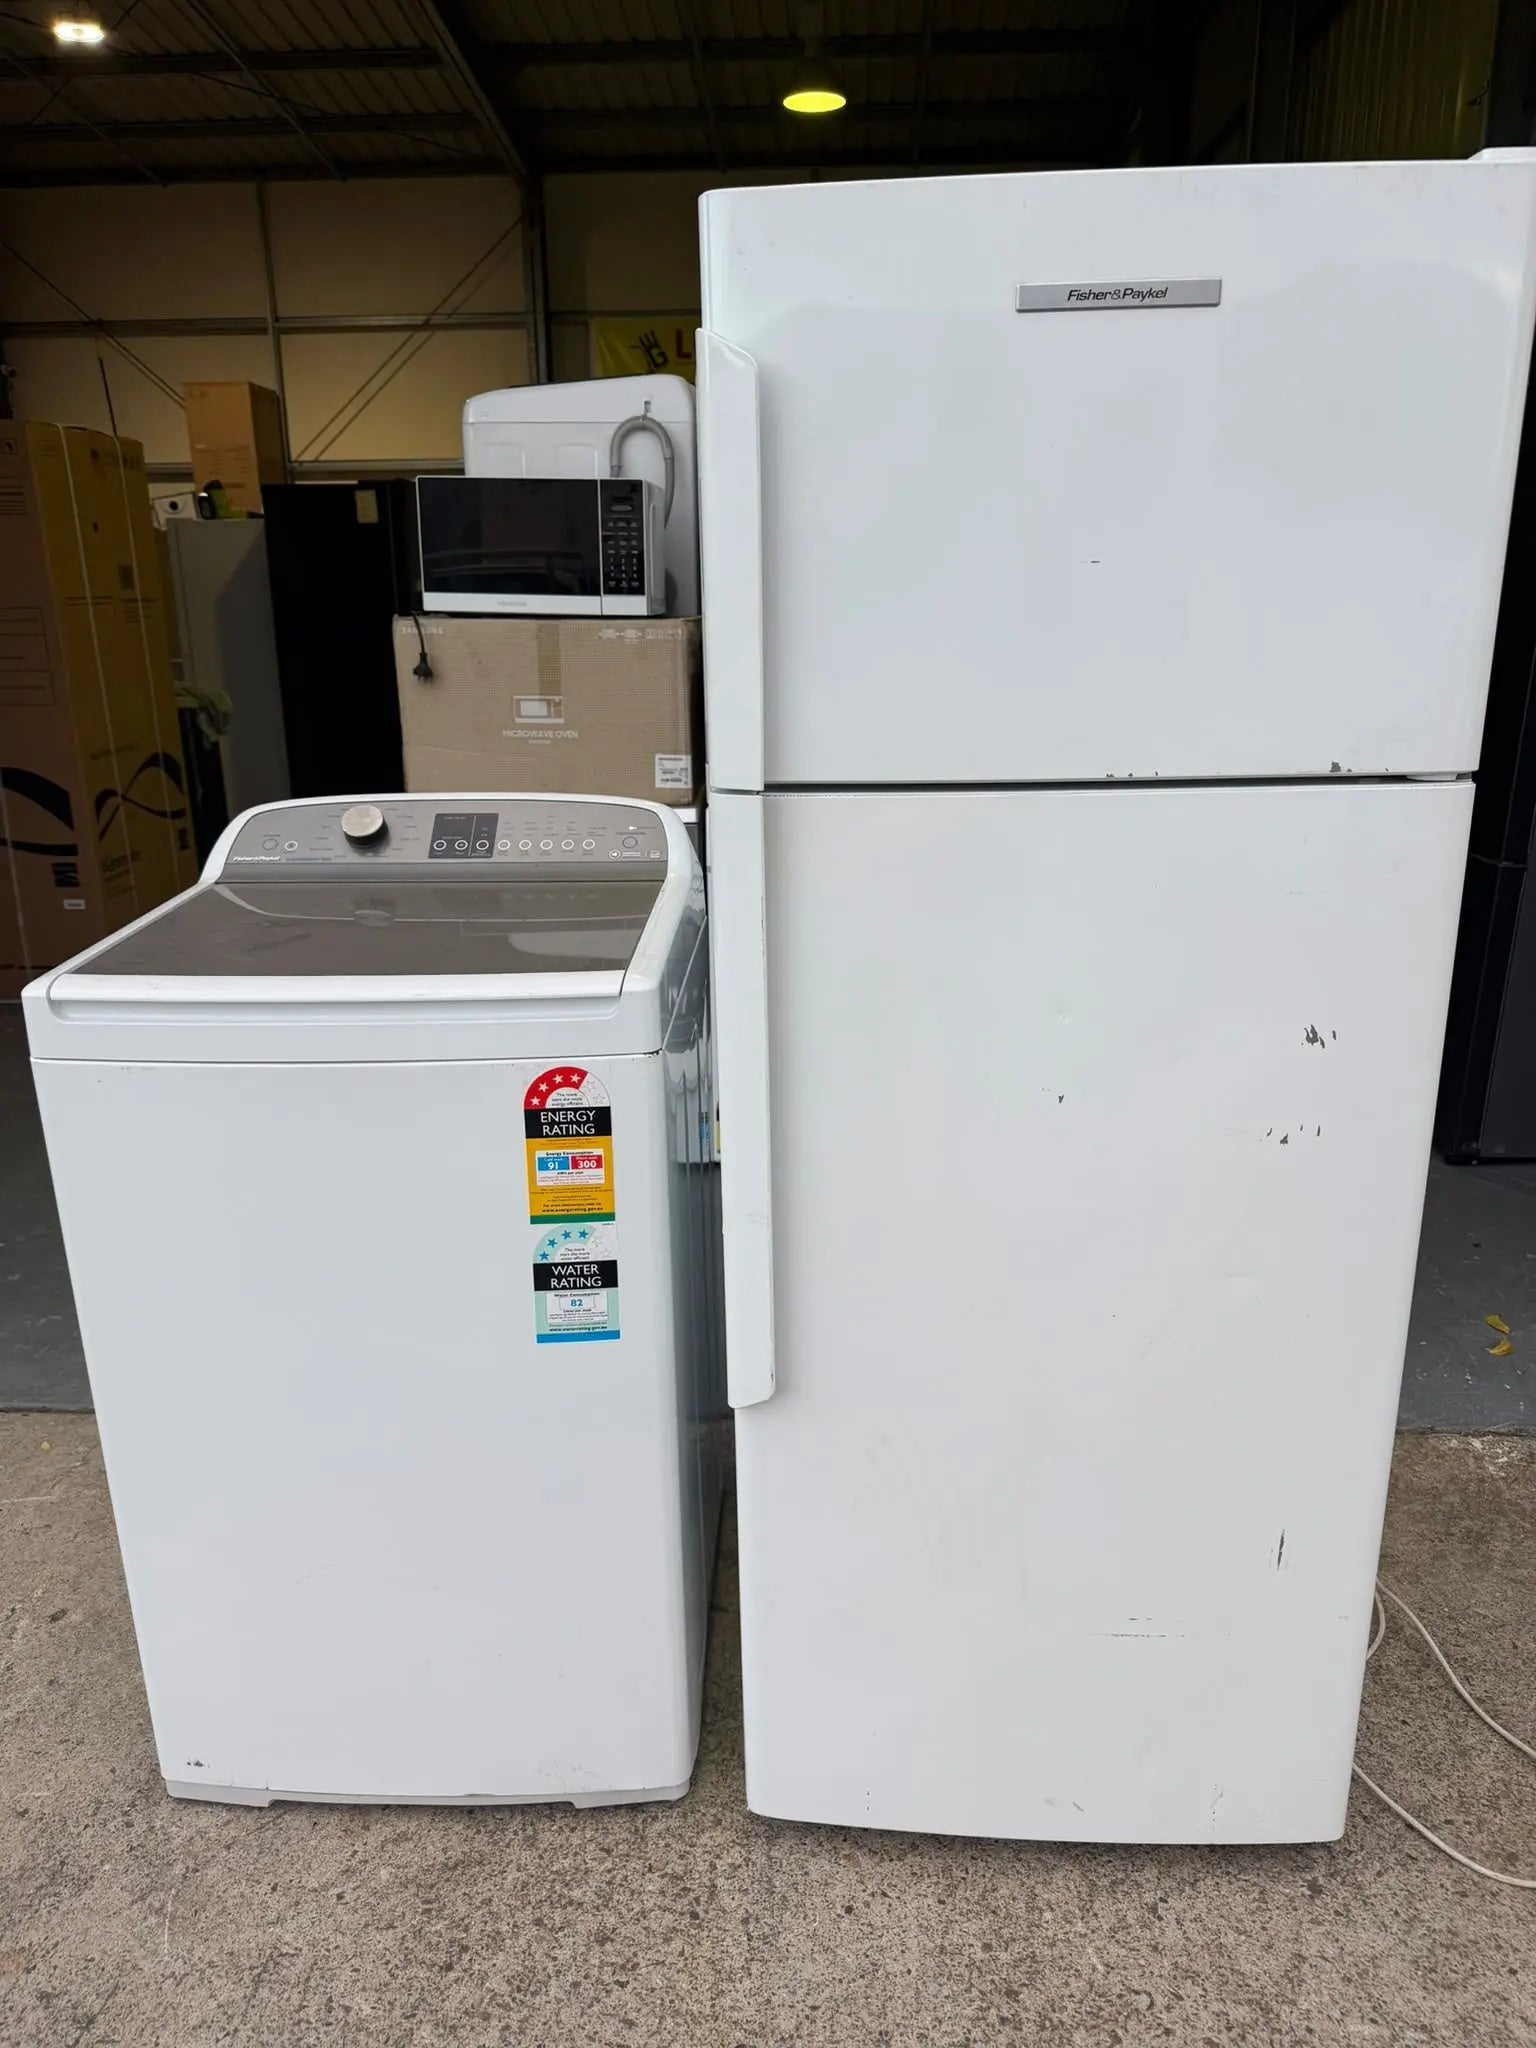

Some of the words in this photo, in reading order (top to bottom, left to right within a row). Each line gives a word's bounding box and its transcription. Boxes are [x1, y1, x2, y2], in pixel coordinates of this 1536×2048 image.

[1067, 287, 1168, 302] Fisher&Paykel
[502, 729, 553, 738] MICROWAVE
[555, 730, 578, 738] OVEN
[540, 1110, 596, 1123] ENERGY
[542, 1124, 595, 1136] RATING
[548, 1162, 559, 1170] 91
[577, 1160, 597, 1169] 300
[552, 1264, 599, 1276] WATER
[550, 1276, 602, 1289] RATING
[570, 1298, 583, 1307] 82
